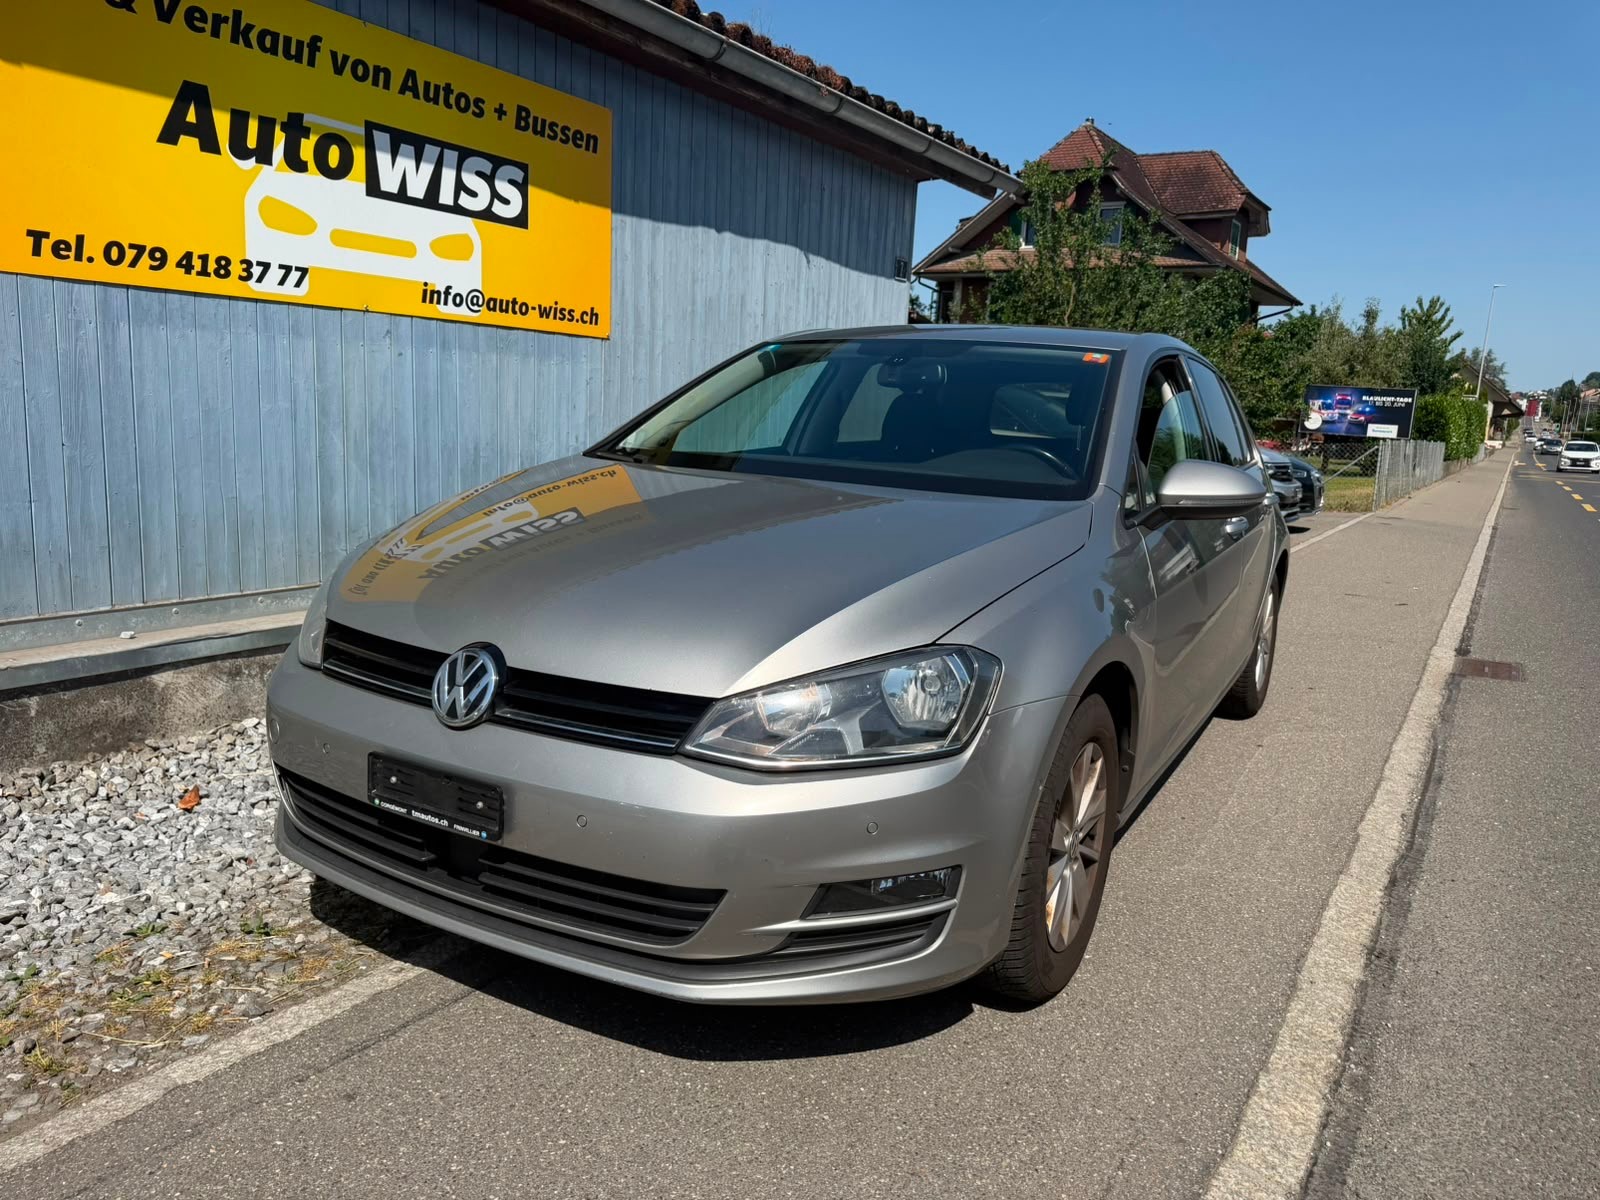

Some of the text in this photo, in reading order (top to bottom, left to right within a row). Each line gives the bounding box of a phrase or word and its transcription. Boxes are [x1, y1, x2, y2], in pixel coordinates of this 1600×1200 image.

[153, 0, 599, 154] Verkauf von Autos + Bussen
[156, 79, 525, 219] Auto WISS
[26, 229, 309, 289] Tel. 079 418 37 77
[420, 281, 600, 326] info@auto-wiss.ch
[411, 810, 449, 827] tmautos.ch
